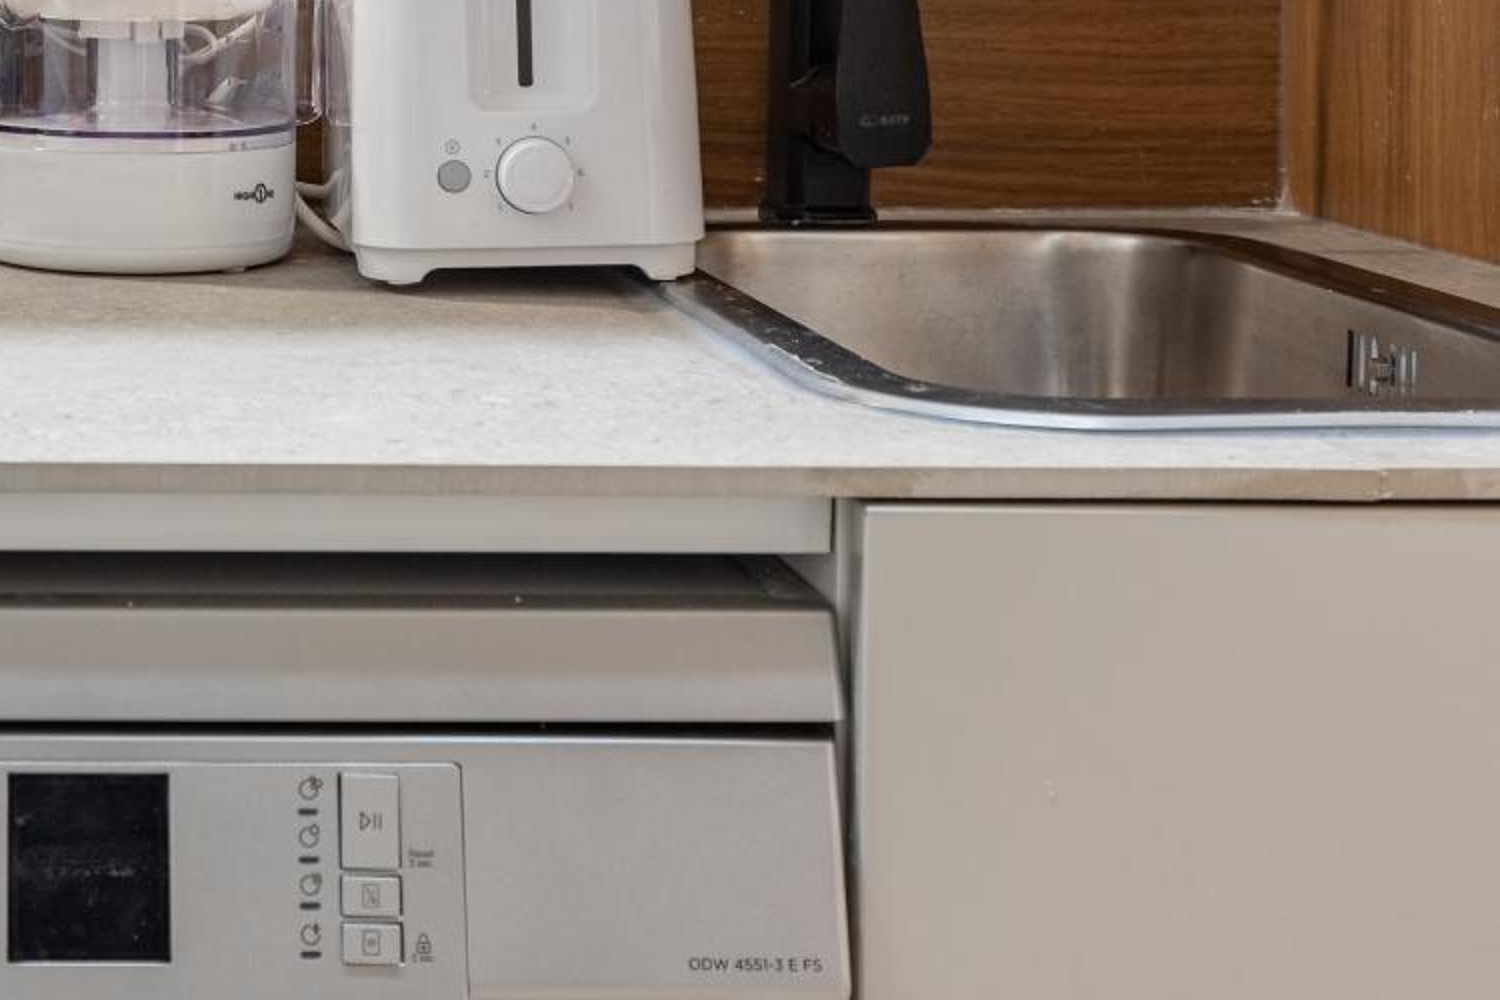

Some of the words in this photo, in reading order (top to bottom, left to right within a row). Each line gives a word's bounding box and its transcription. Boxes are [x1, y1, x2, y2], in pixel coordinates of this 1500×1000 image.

[688, 957, 729, 971] ODW
[734, 958, 783, 972] 4551-3
[788, 958, 798, 972] E
